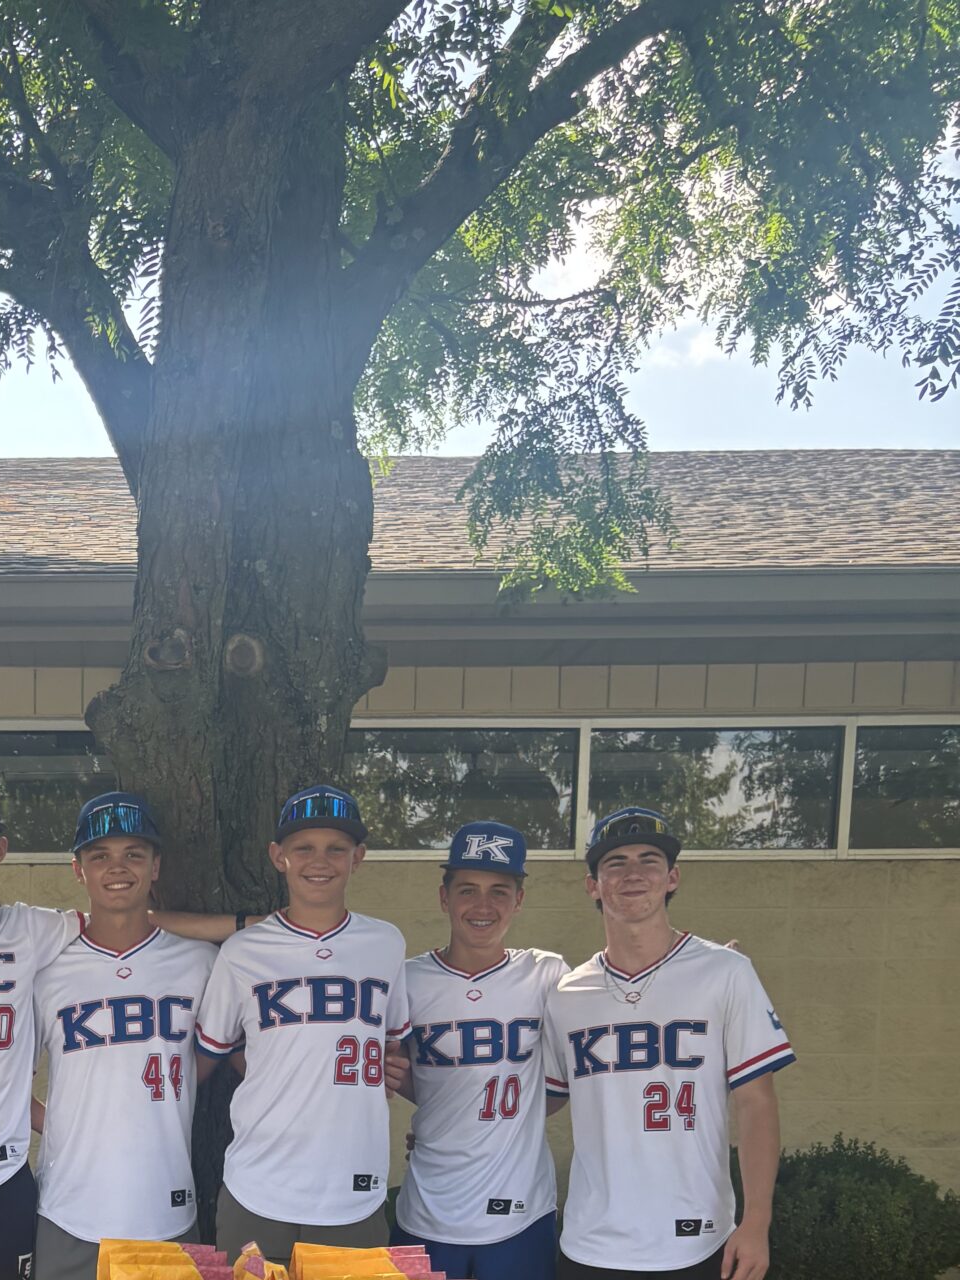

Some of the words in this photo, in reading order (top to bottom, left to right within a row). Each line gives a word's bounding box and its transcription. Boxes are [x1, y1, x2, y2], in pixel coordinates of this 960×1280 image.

[461, 834, 514, 864] K
[56, 994, 194, 1055] KBC
[251, 975, 390, 1032] KBC
[333, 1035, 383, 1087] 28
[412, 1017, 542, 1068] KBC
[567, 1019, 709, 1080] KBC
[141, 1053, 183, 1101] 44
[478, 1074, 521, 1121] 10
[643, 1081, 696, 1131] 24
